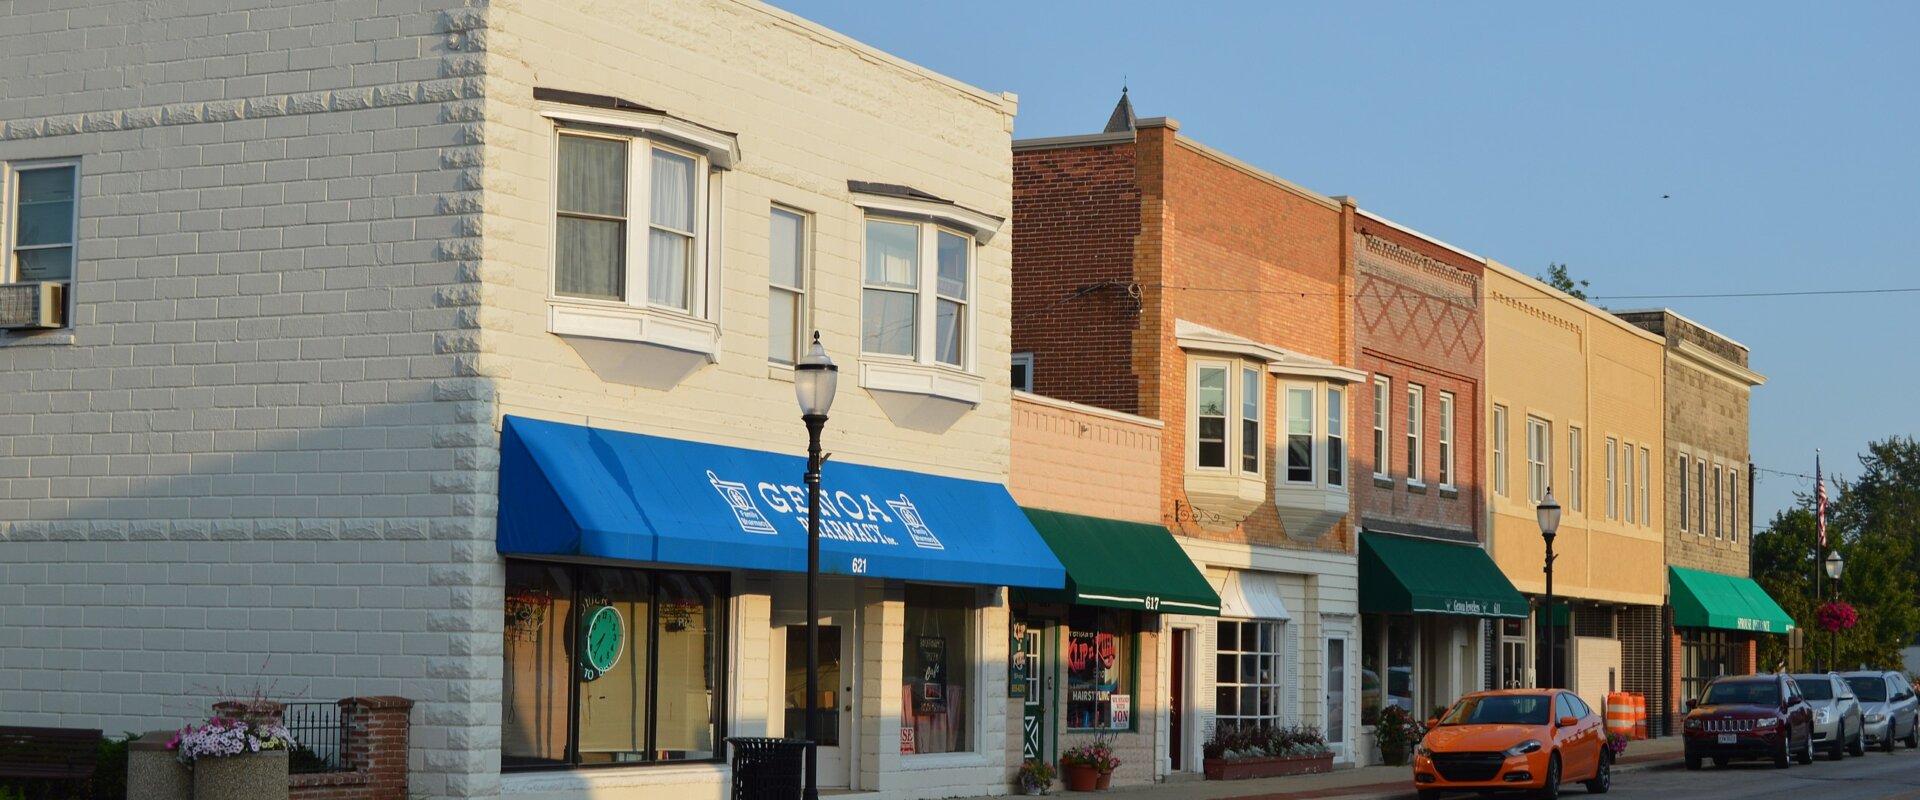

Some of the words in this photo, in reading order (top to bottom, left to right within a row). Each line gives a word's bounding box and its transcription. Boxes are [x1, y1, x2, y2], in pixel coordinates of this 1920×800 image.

[757, 481, 893, 523] GENOA
[739, 510, 759, 520] Family
[851, 557, 867, 574] 621
[1145, 595, 1160, 611] 617
[1112, 710, 1129, 723] JON
